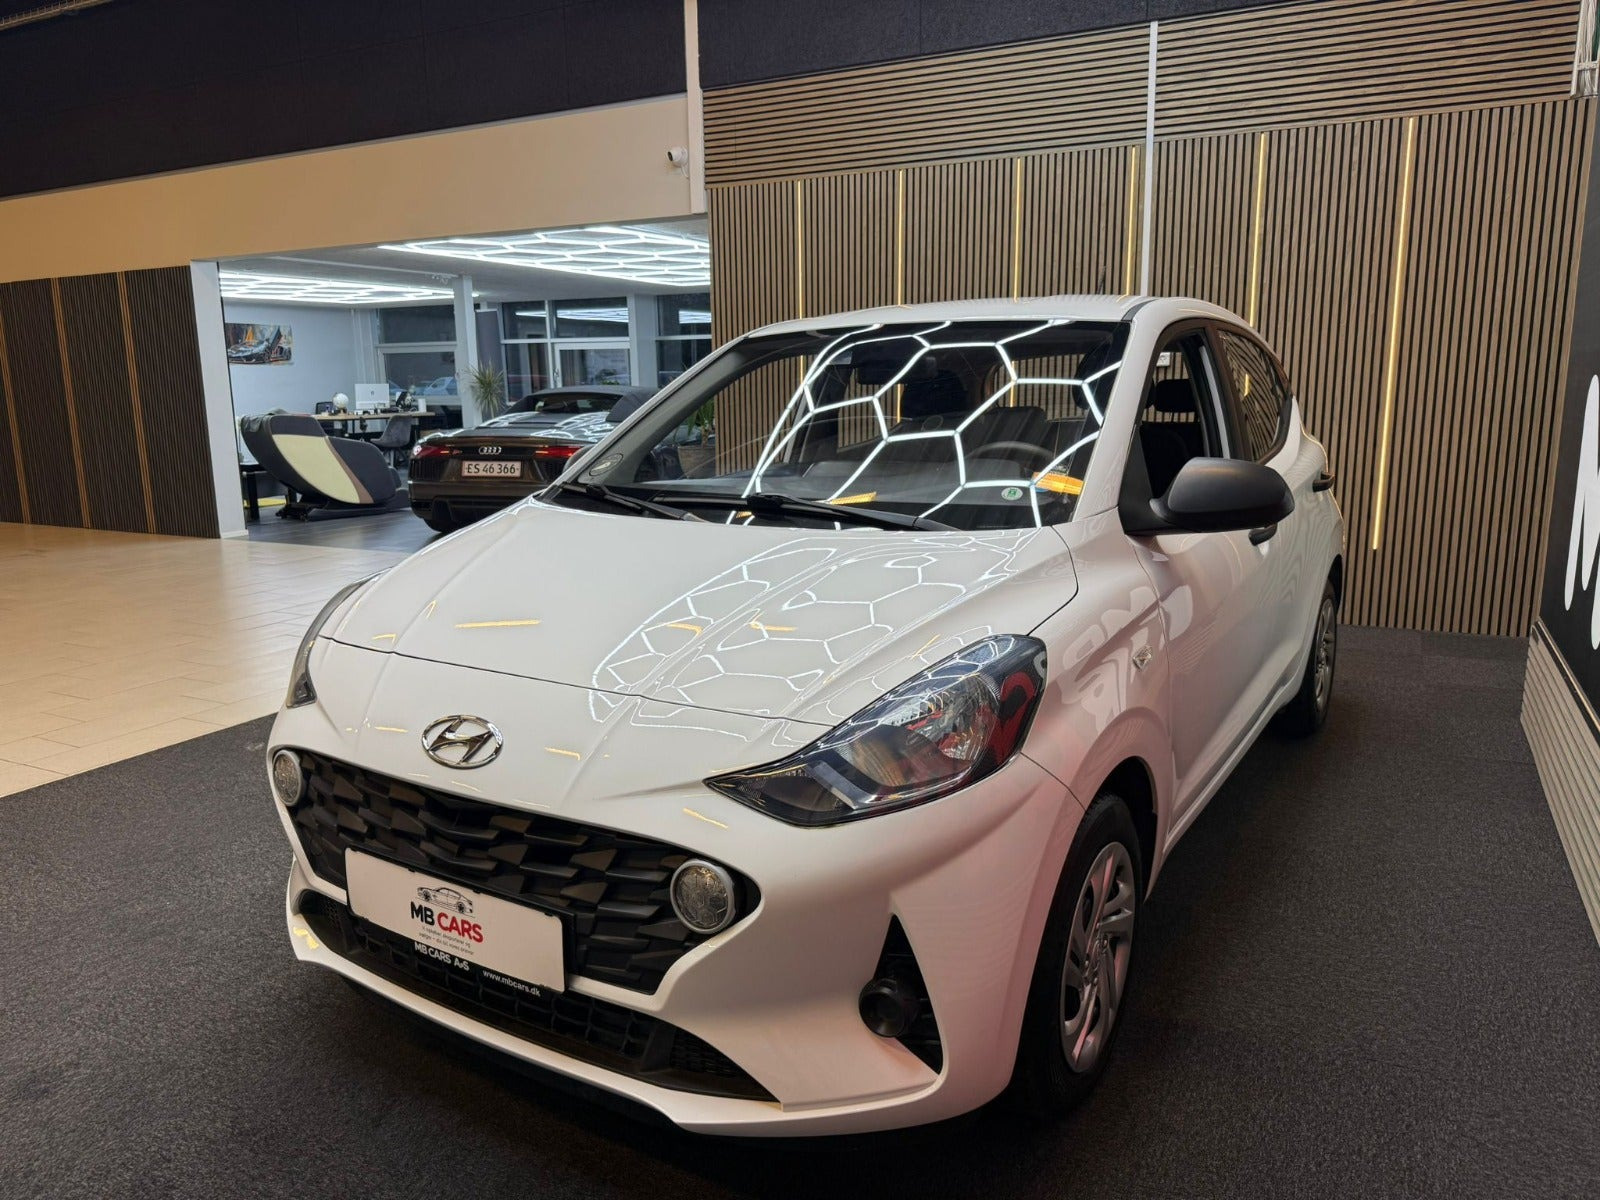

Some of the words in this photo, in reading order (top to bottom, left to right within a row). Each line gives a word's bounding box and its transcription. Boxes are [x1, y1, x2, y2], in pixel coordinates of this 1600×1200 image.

[467, 463, 480, 474] ES
[482, 463, 495, 474] 46
[496, 463, 516, 474] 366
[410, 901, 435, 926] MB
[437, 912, 484, 943] CARS
[414, 940, 428, 955] MB
[428, 947, 452, 964] CARS
[482, 970, 541, 997] www.mbcars.dk
